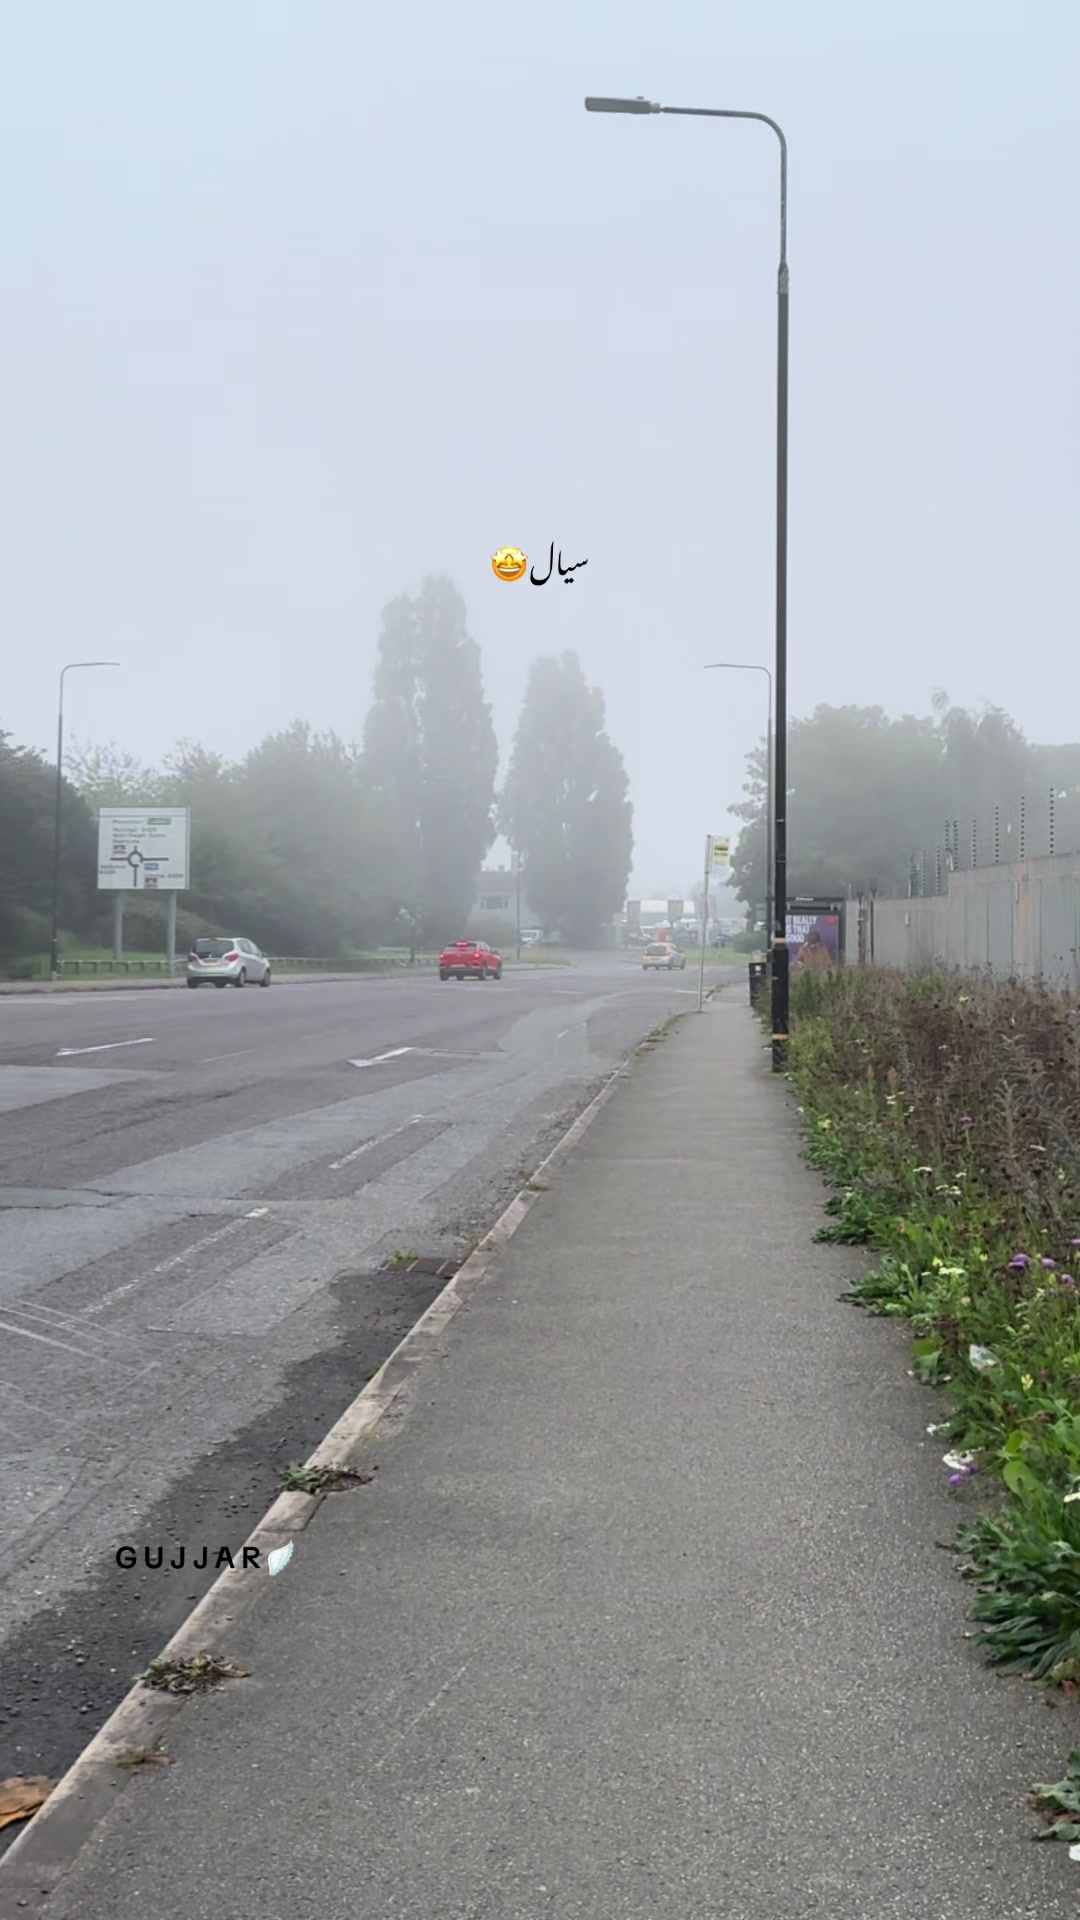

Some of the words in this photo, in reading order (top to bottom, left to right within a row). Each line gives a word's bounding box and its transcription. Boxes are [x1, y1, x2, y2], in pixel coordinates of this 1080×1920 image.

[793, 915, 817, 925] REALLY
[793, 924, 810, 935] THAT
[785, 934, 805, 943] GOOD
